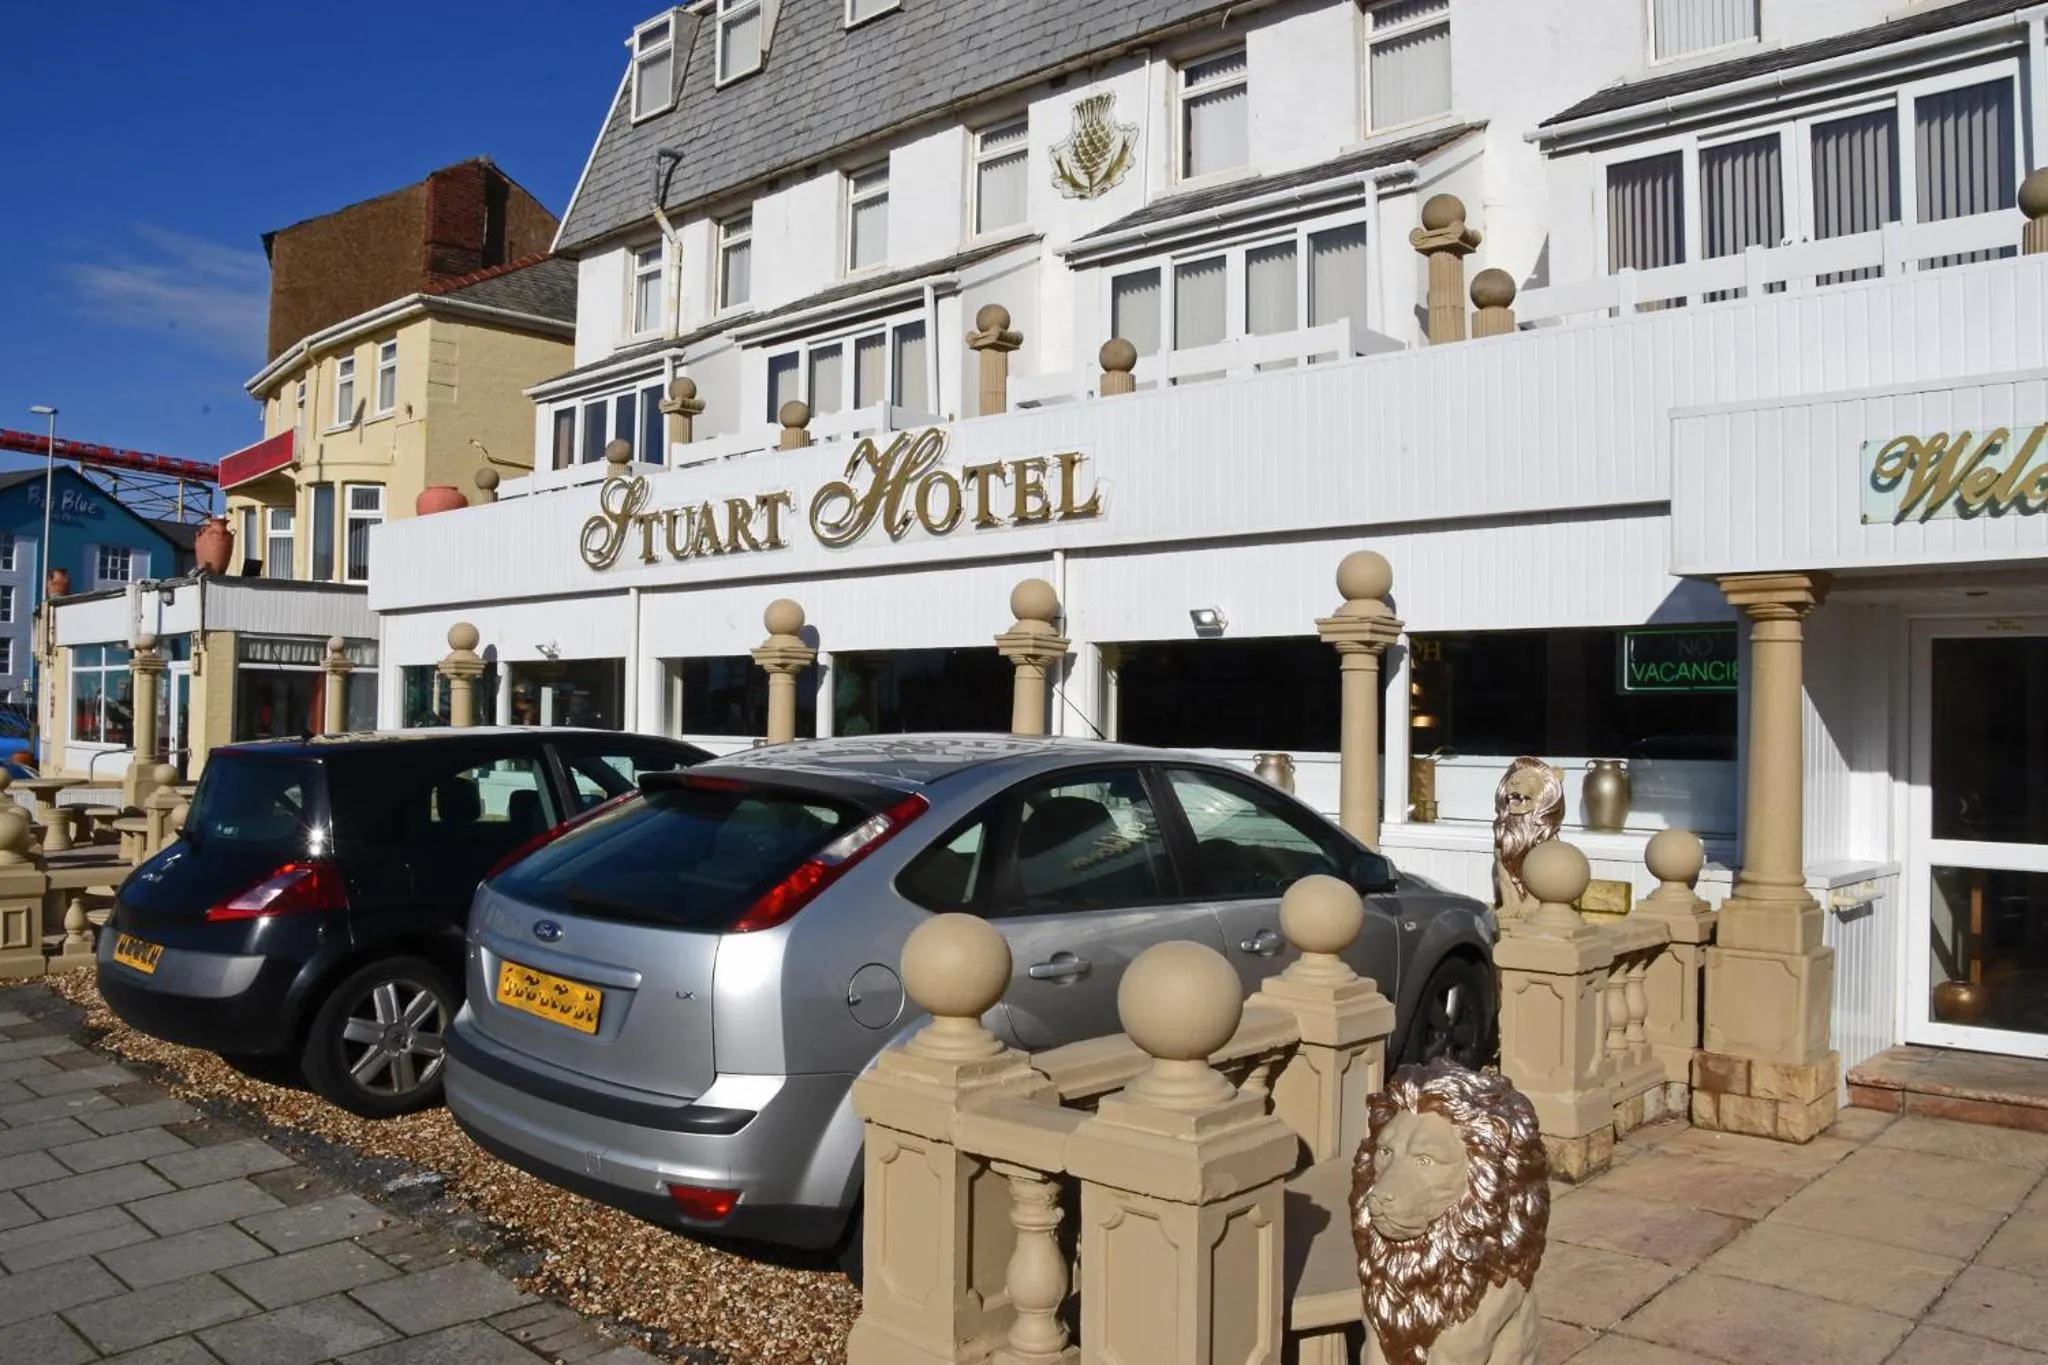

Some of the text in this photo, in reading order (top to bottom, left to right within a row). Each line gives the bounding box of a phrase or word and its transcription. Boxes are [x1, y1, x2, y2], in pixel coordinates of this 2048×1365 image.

[61, 489, 97, 514] Blue
[581, 427, 1104, 570] STUART HOTEL
[1679, 636, 1714, 657] NO
